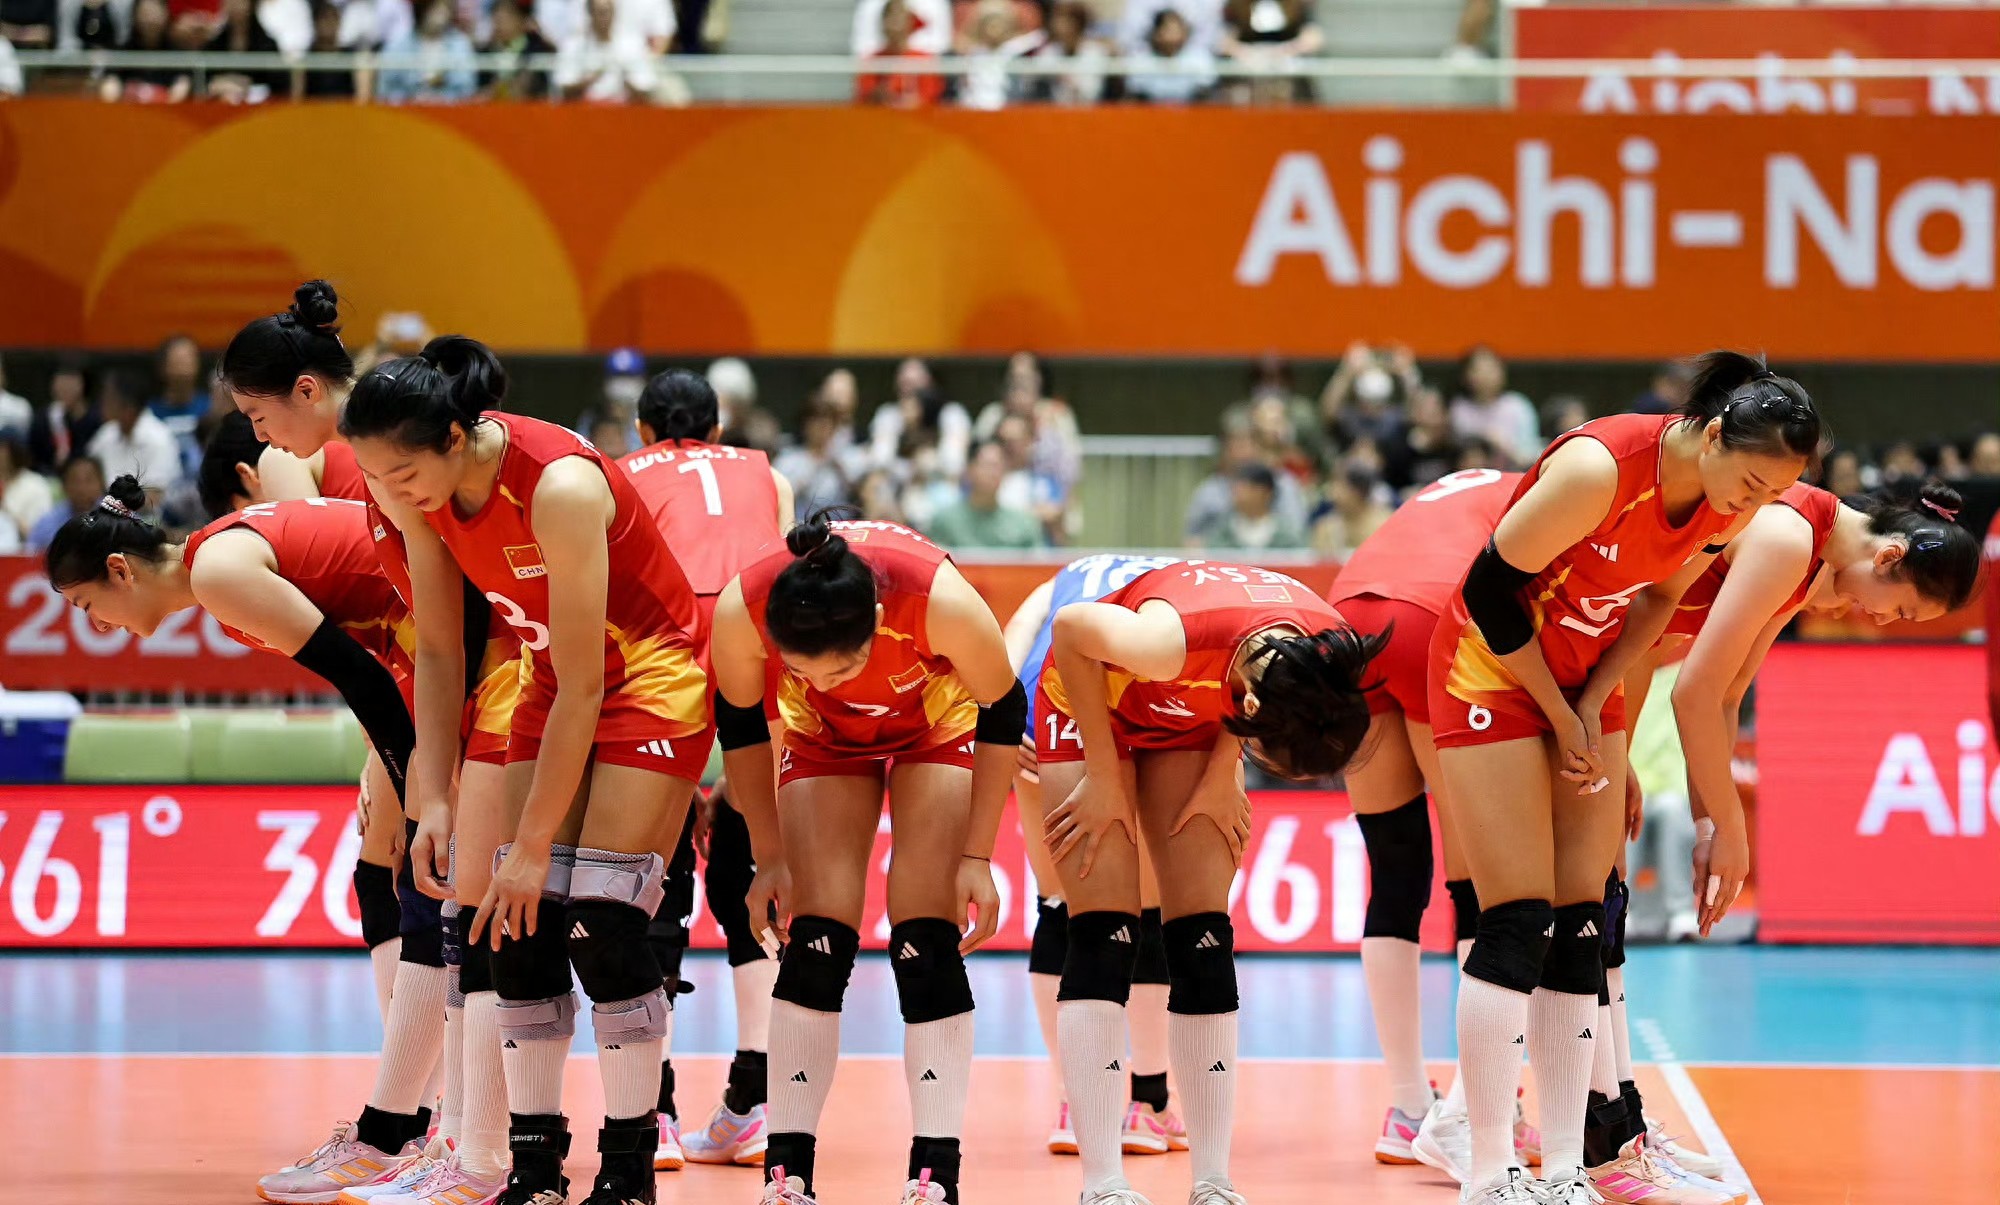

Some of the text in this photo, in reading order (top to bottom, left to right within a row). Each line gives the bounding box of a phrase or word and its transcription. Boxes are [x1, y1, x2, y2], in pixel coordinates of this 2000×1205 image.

[628, 451, 675, 474] WU
[678, 458, 722, 516] 1
[518, 566, 544, 577] CHN
[1046, 713, 1084, 750] 14
[1468, 704, 1492, 731] 6
[1856, 719, 2000, 837] Ai
[0, 795, 184, 937] 61°
